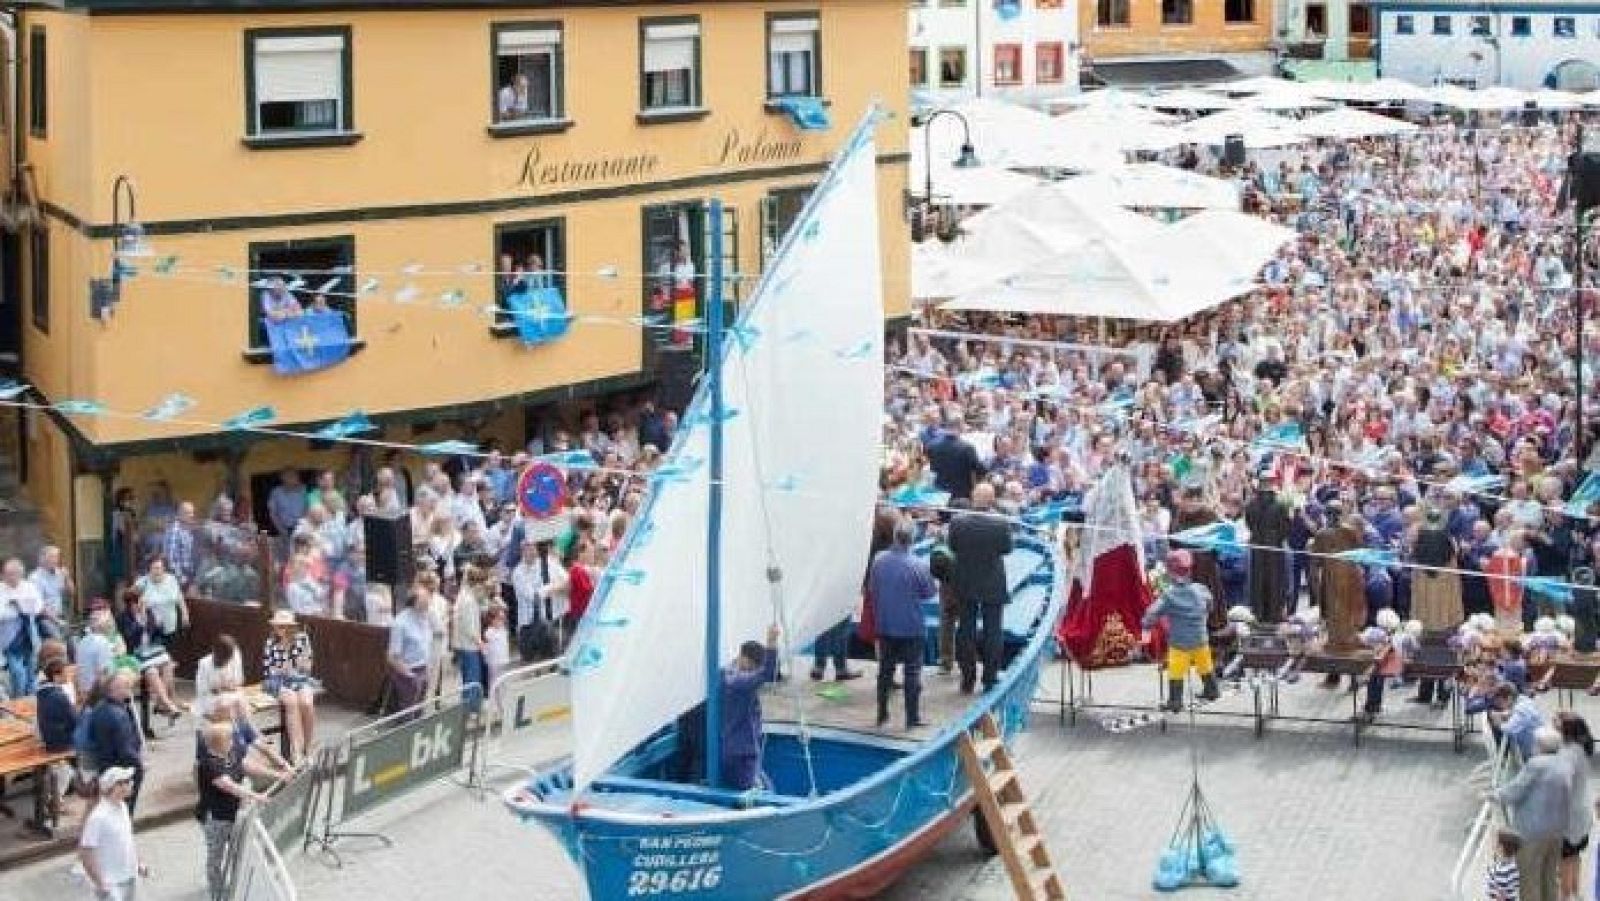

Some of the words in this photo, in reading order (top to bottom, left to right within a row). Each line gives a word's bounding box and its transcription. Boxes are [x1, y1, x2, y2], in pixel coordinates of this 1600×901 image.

[517, 142, 658, 186] Restaurante
[720, 129, 803, 163] Paloma
[628, 866, 723, 896] 29616
